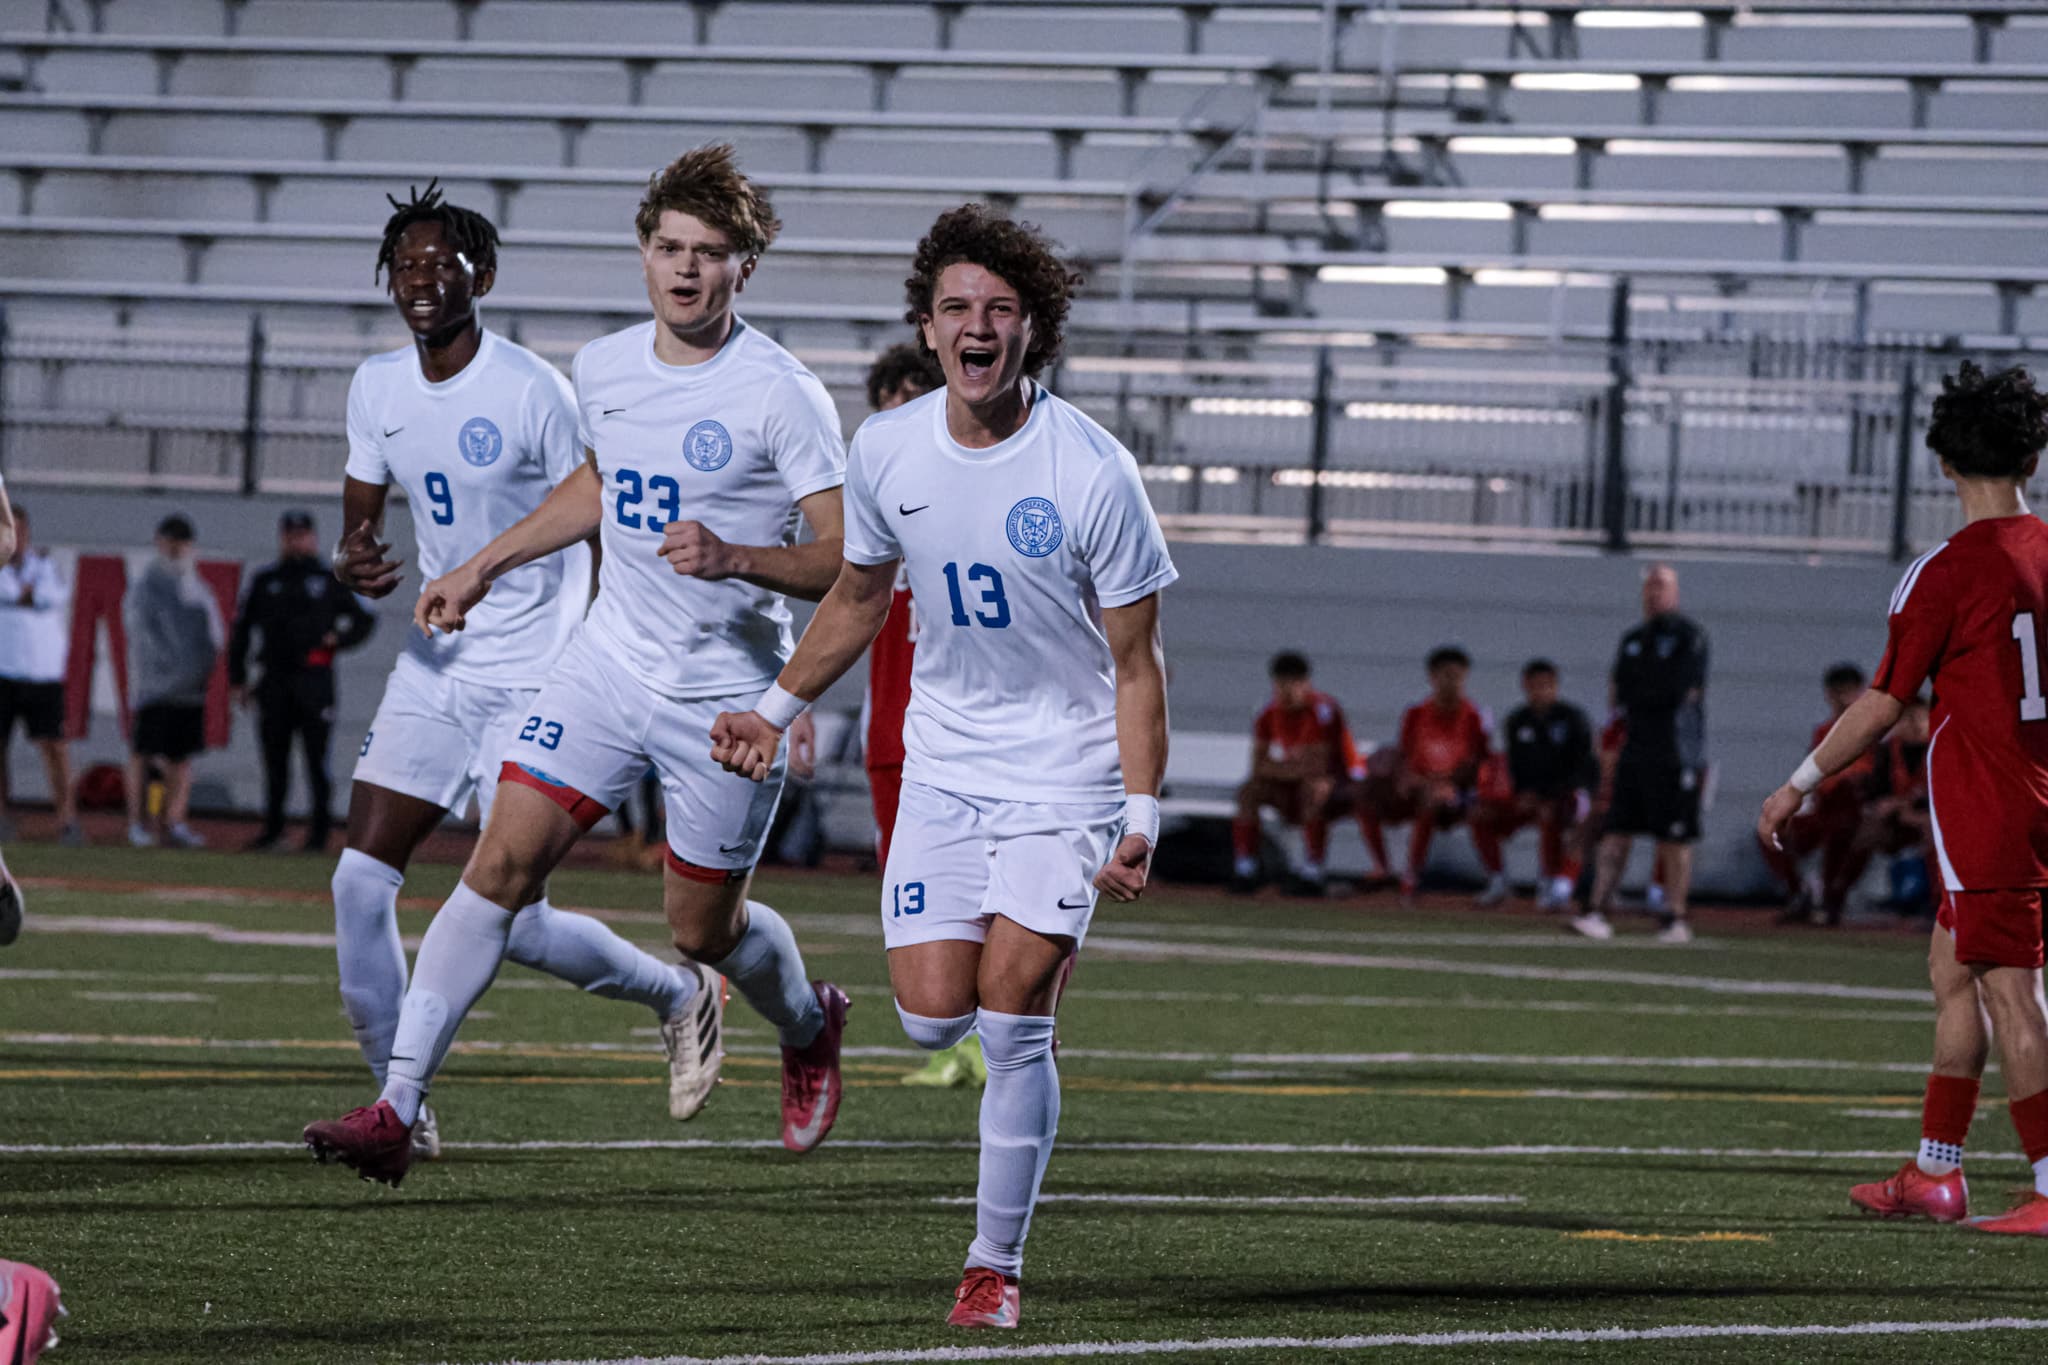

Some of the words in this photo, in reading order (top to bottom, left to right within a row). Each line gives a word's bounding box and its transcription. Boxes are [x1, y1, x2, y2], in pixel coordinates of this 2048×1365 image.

[424, 471, 454, 526] 9
[615, 468, 680, 533] 23
[942, 562, 1011, 629] 13
[518, 716, 564, 751] 23
[894, 881, 925, 918] 13
